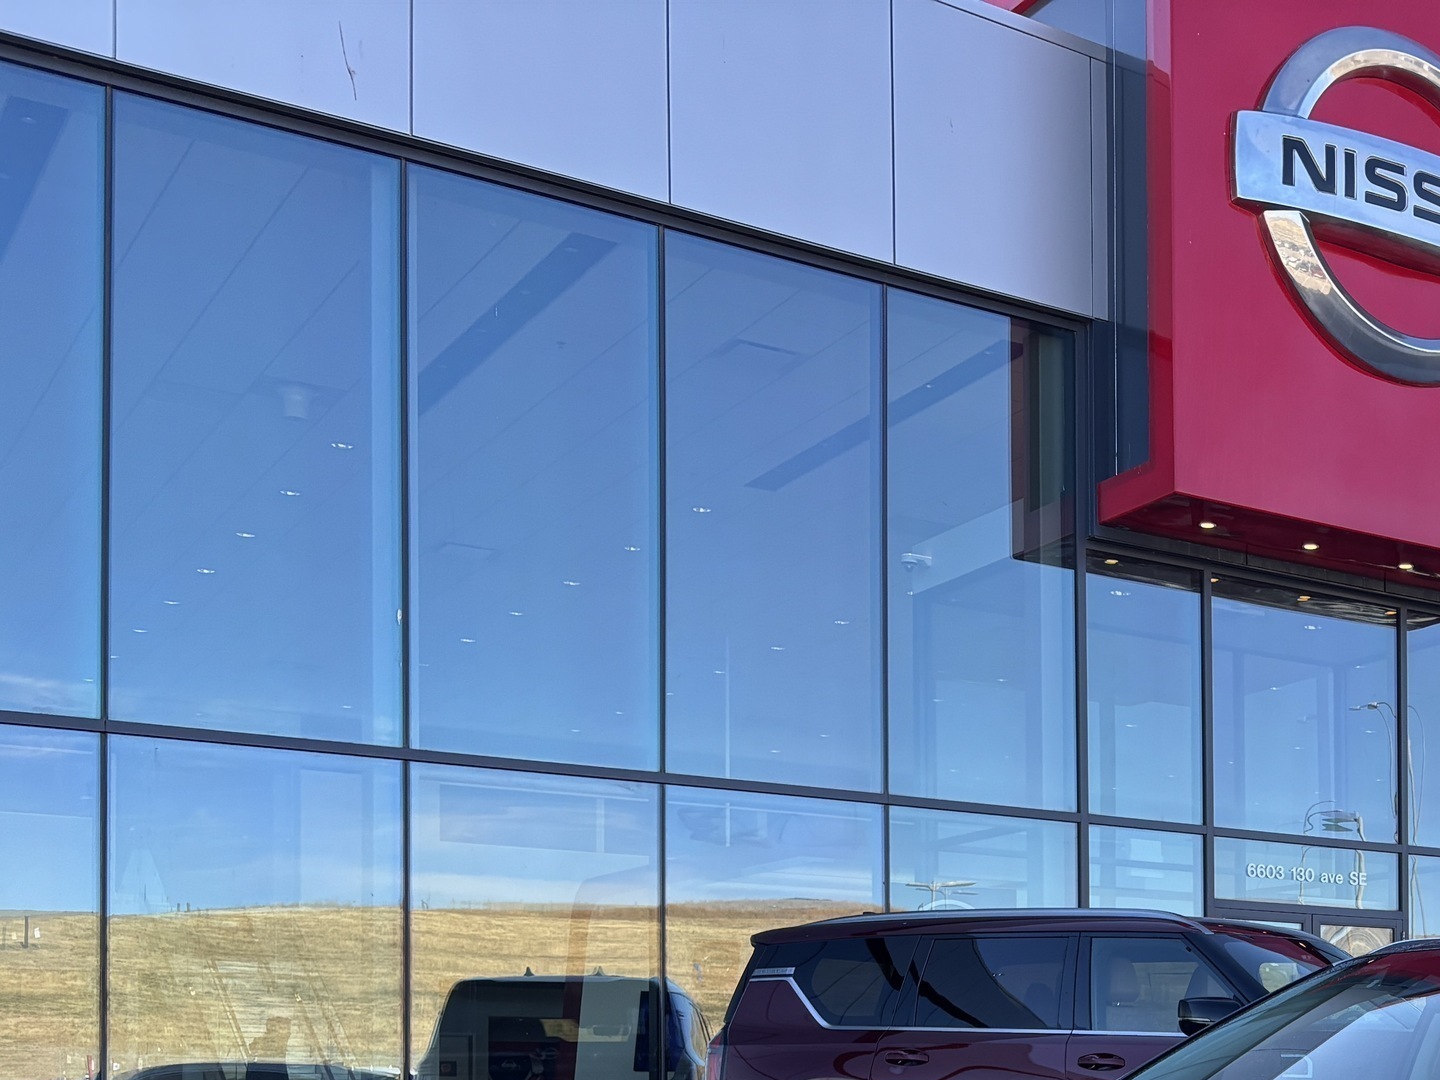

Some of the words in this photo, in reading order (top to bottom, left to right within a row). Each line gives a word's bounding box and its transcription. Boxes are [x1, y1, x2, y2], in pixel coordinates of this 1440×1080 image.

[1247, 863, 1285, 879] 6603
[1290, 866, 1315, 882] 130
[1320, 872, 1344, 885] ave
[1349, 871, 1368, 886] SE
